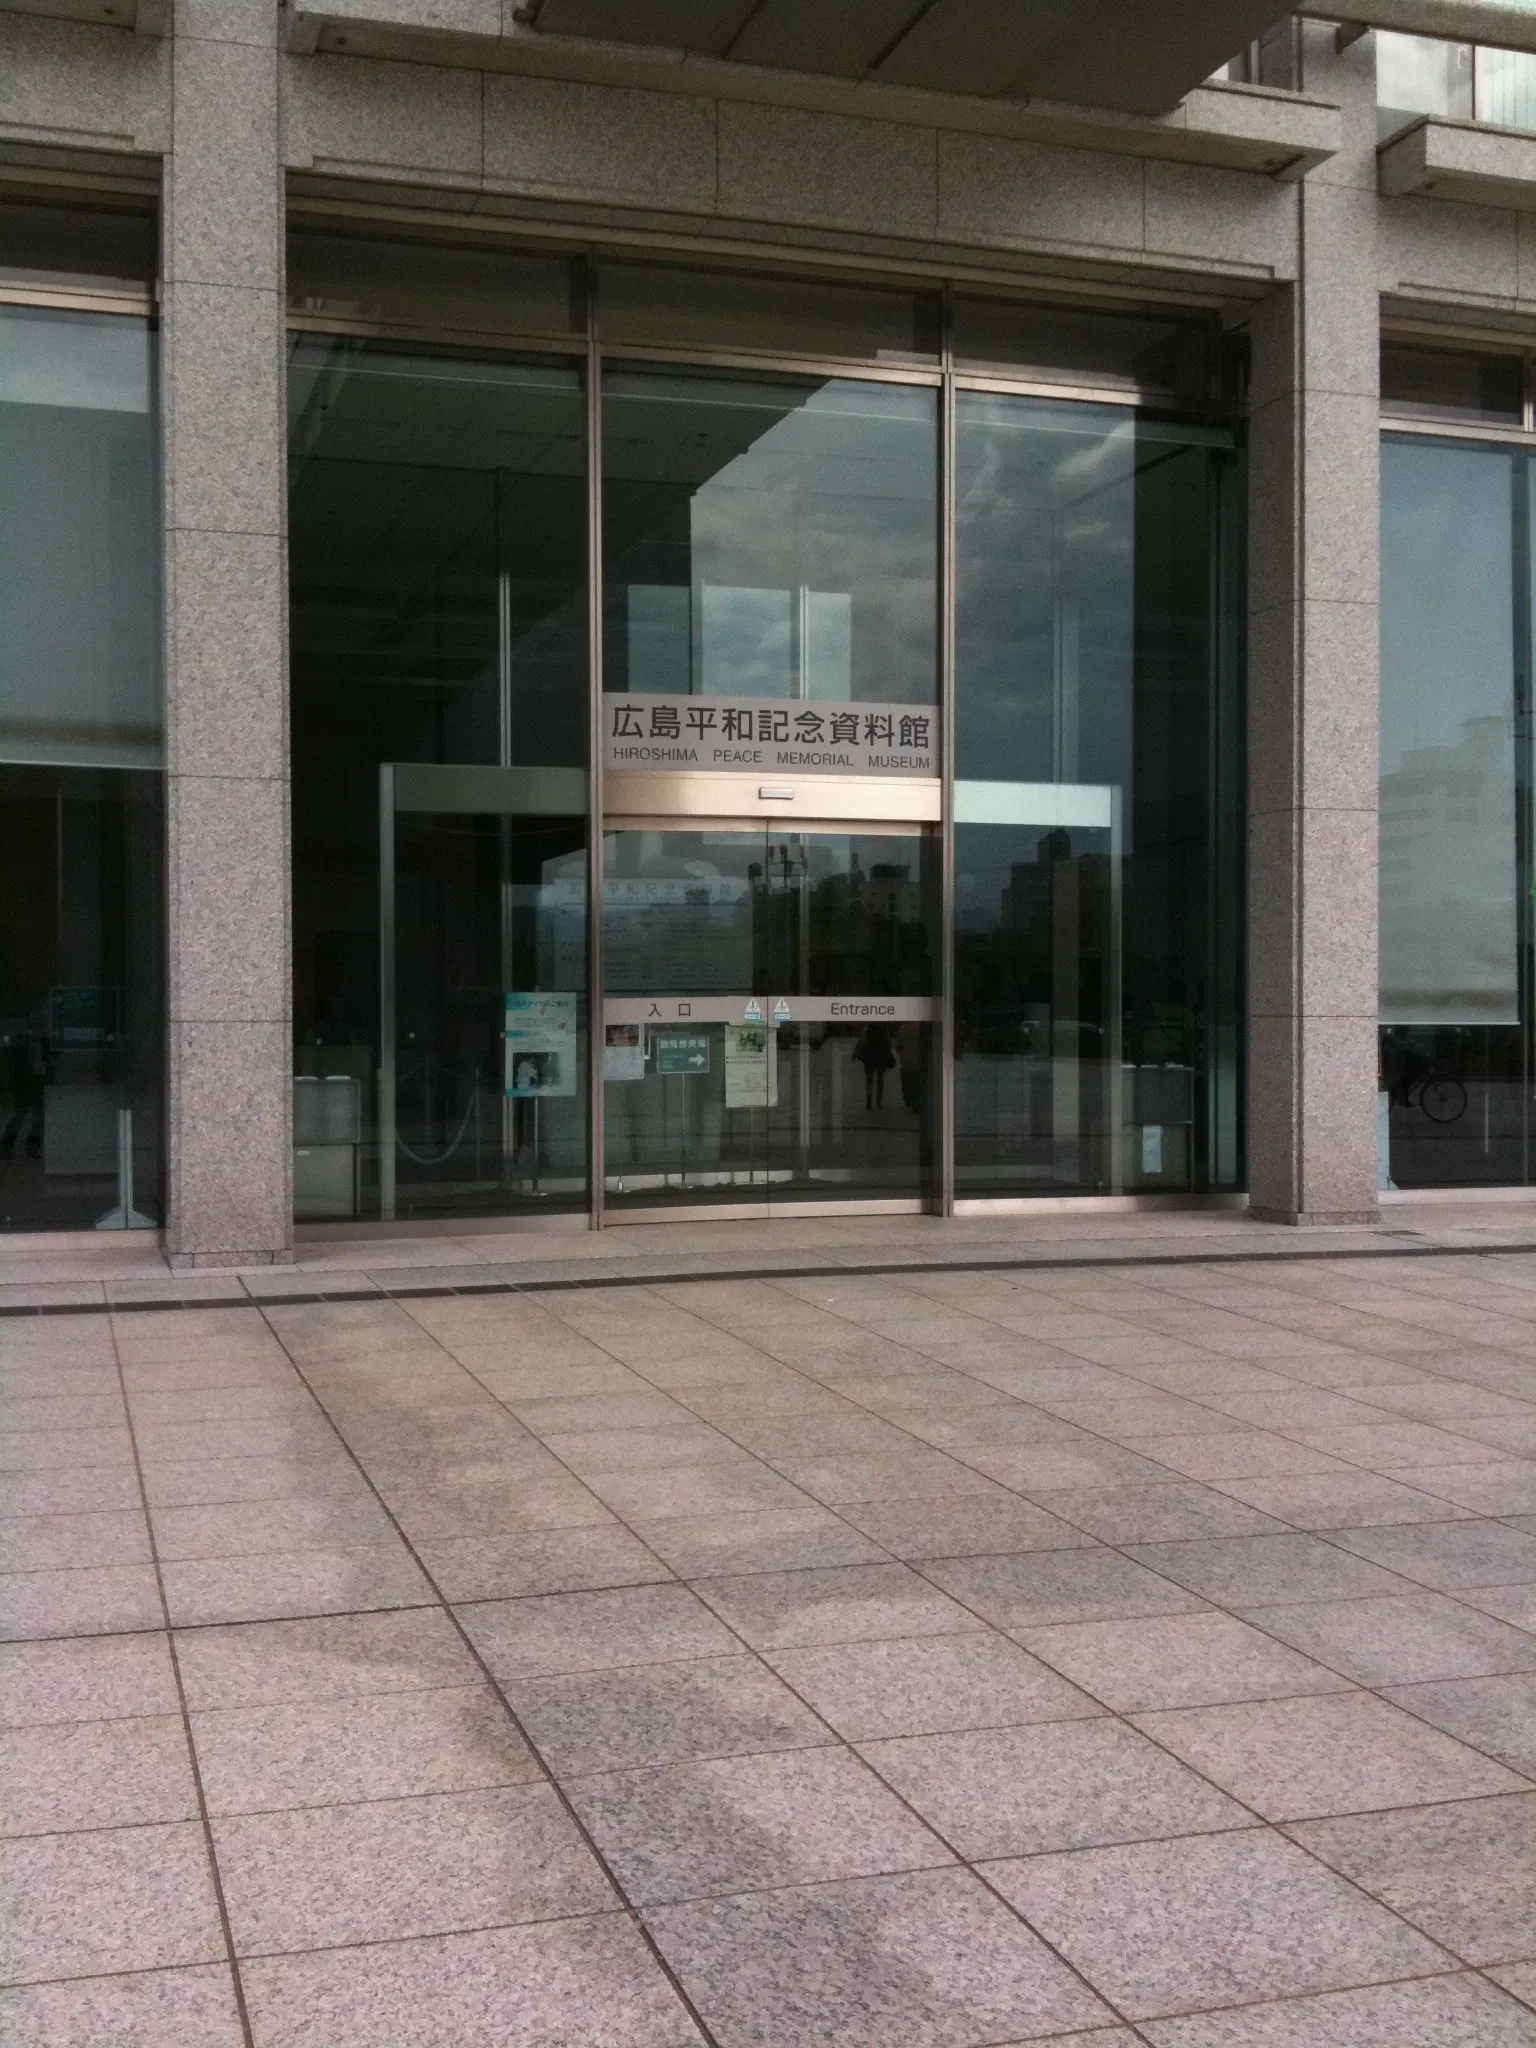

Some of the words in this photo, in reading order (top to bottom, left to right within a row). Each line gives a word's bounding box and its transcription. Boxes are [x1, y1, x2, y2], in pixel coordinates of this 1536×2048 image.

[612, 704, 930, 749] 広島平和記念資料館
[613, 747, 699, 762] HIROSHIMA
[713, 750, 763, 764] PEACE
[776, 752, 854, 767] MEMORIAL
[868, 755, 931, 769] MUSEUM
[648, 1003, 692, 1017] 入口
[830, 1002, 896, 1017] Entrance
